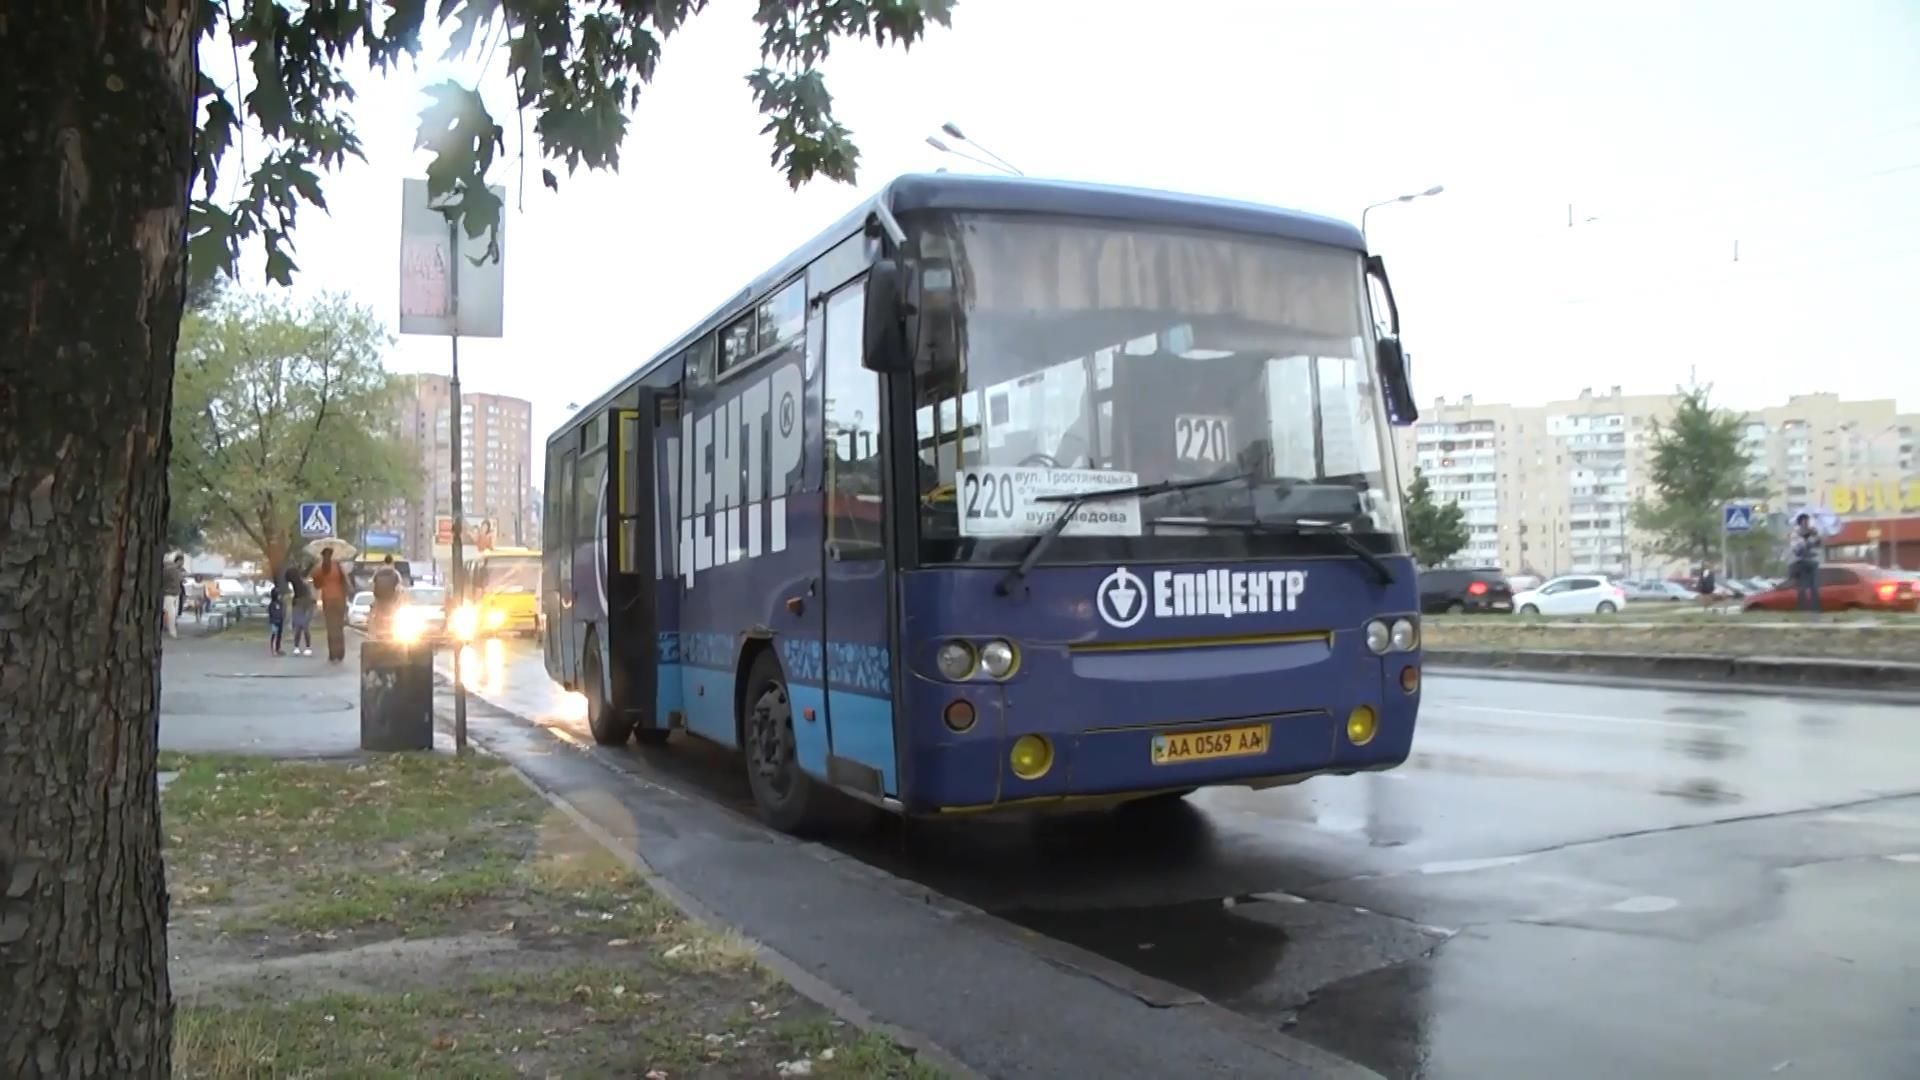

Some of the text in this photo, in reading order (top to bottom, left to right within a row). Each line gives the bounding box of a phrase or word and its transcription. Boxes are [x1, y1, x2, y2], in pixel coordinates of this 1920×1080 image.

[1178, 419, 1226, 461] 220
[1015, 471, 1041, 484] вул.
[964, 473, 1014, 519] 220
[1195, 733, 1232, 754] 0569
